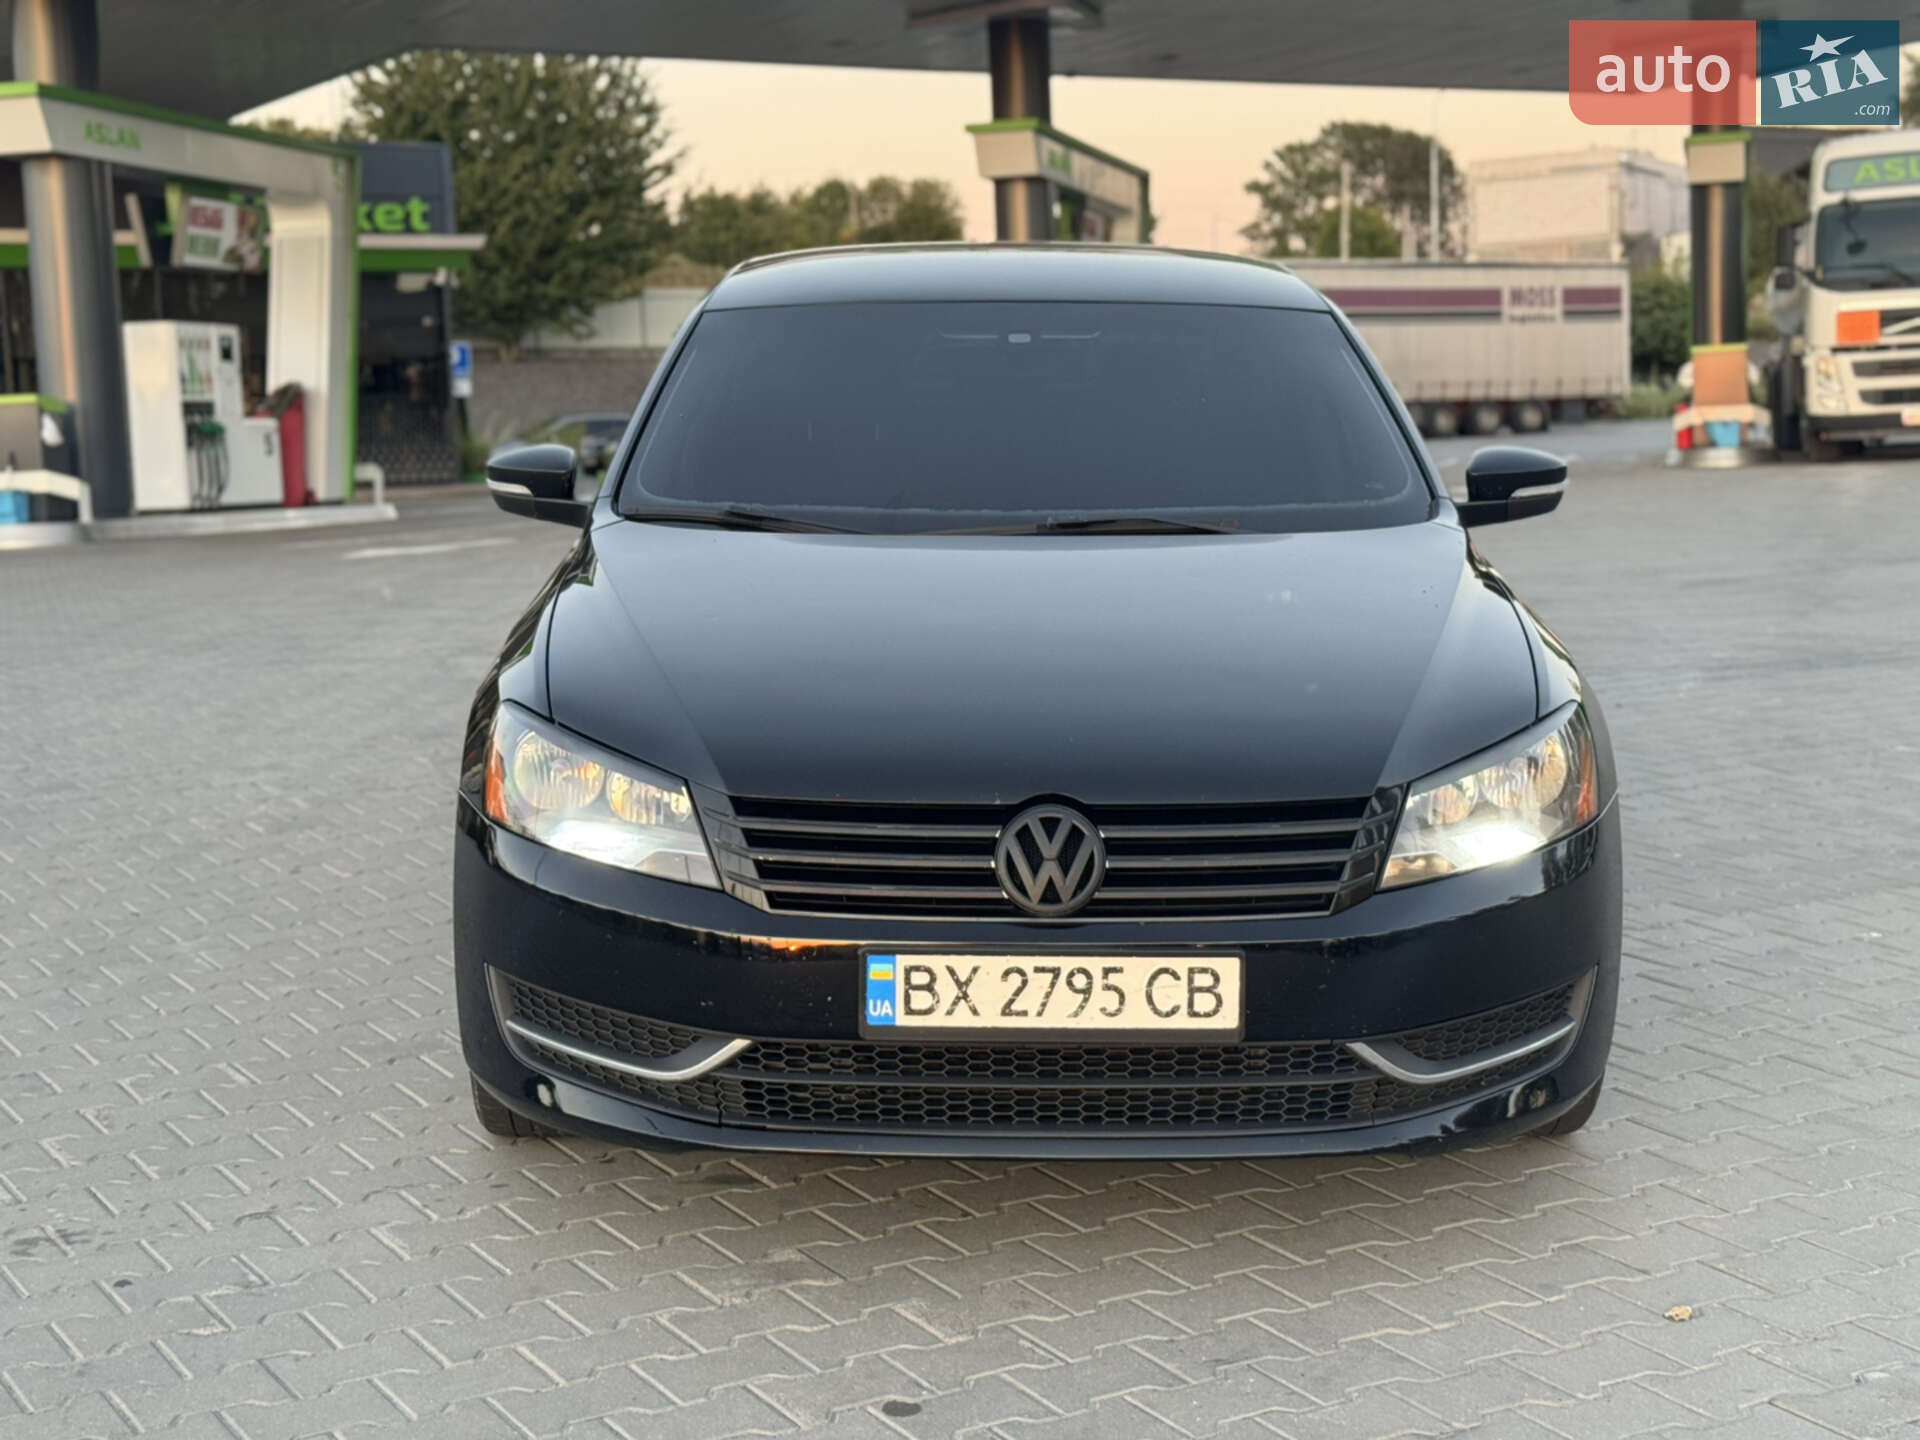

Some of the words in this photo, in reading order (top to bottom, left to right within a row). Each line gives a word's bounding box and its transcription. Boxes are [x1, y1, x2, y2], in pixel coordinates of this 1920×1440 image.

[868, 999, 893, 1018] UA
[903, 964, 981, 1017] BX
[1000, 965, 1126, 1018] 2795
[1145, 966, 1224, 1019] CB
